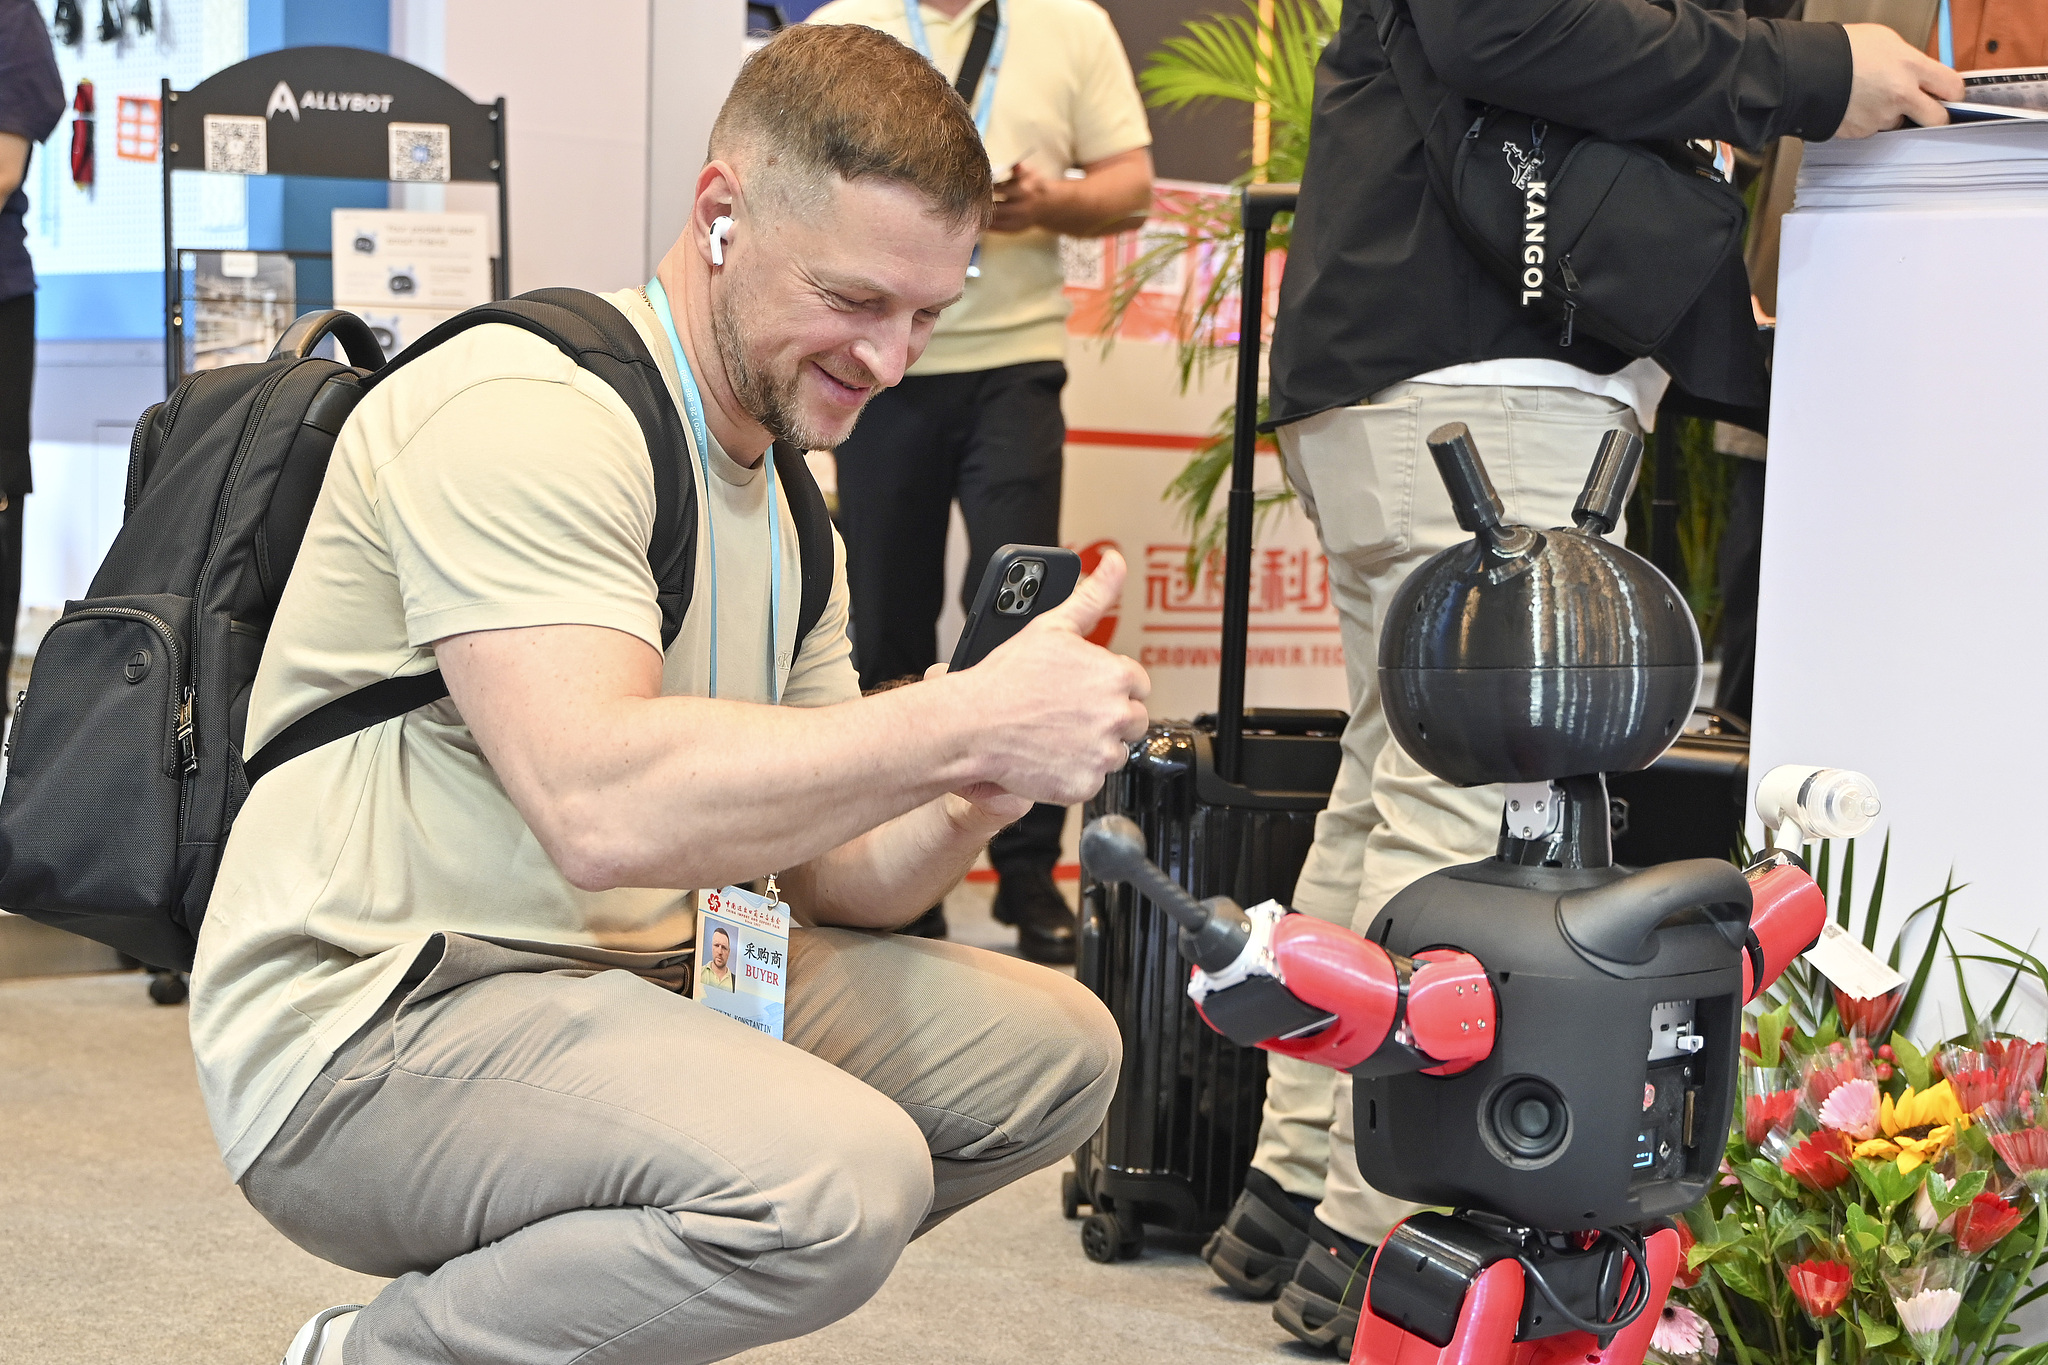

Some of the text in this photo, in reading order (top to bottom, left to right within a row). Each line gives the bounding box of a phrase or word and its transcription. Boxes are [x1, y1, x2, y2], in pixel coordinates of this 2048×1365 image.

[300, 90, 394, 113] ALLYBOT
[1522, 181, 1547, 305] KANGOL
[1246, 646, 1303, 668] OWER
[743, 942, 783, 969] 采购商
[745, 964, 780, 986] BUYER
